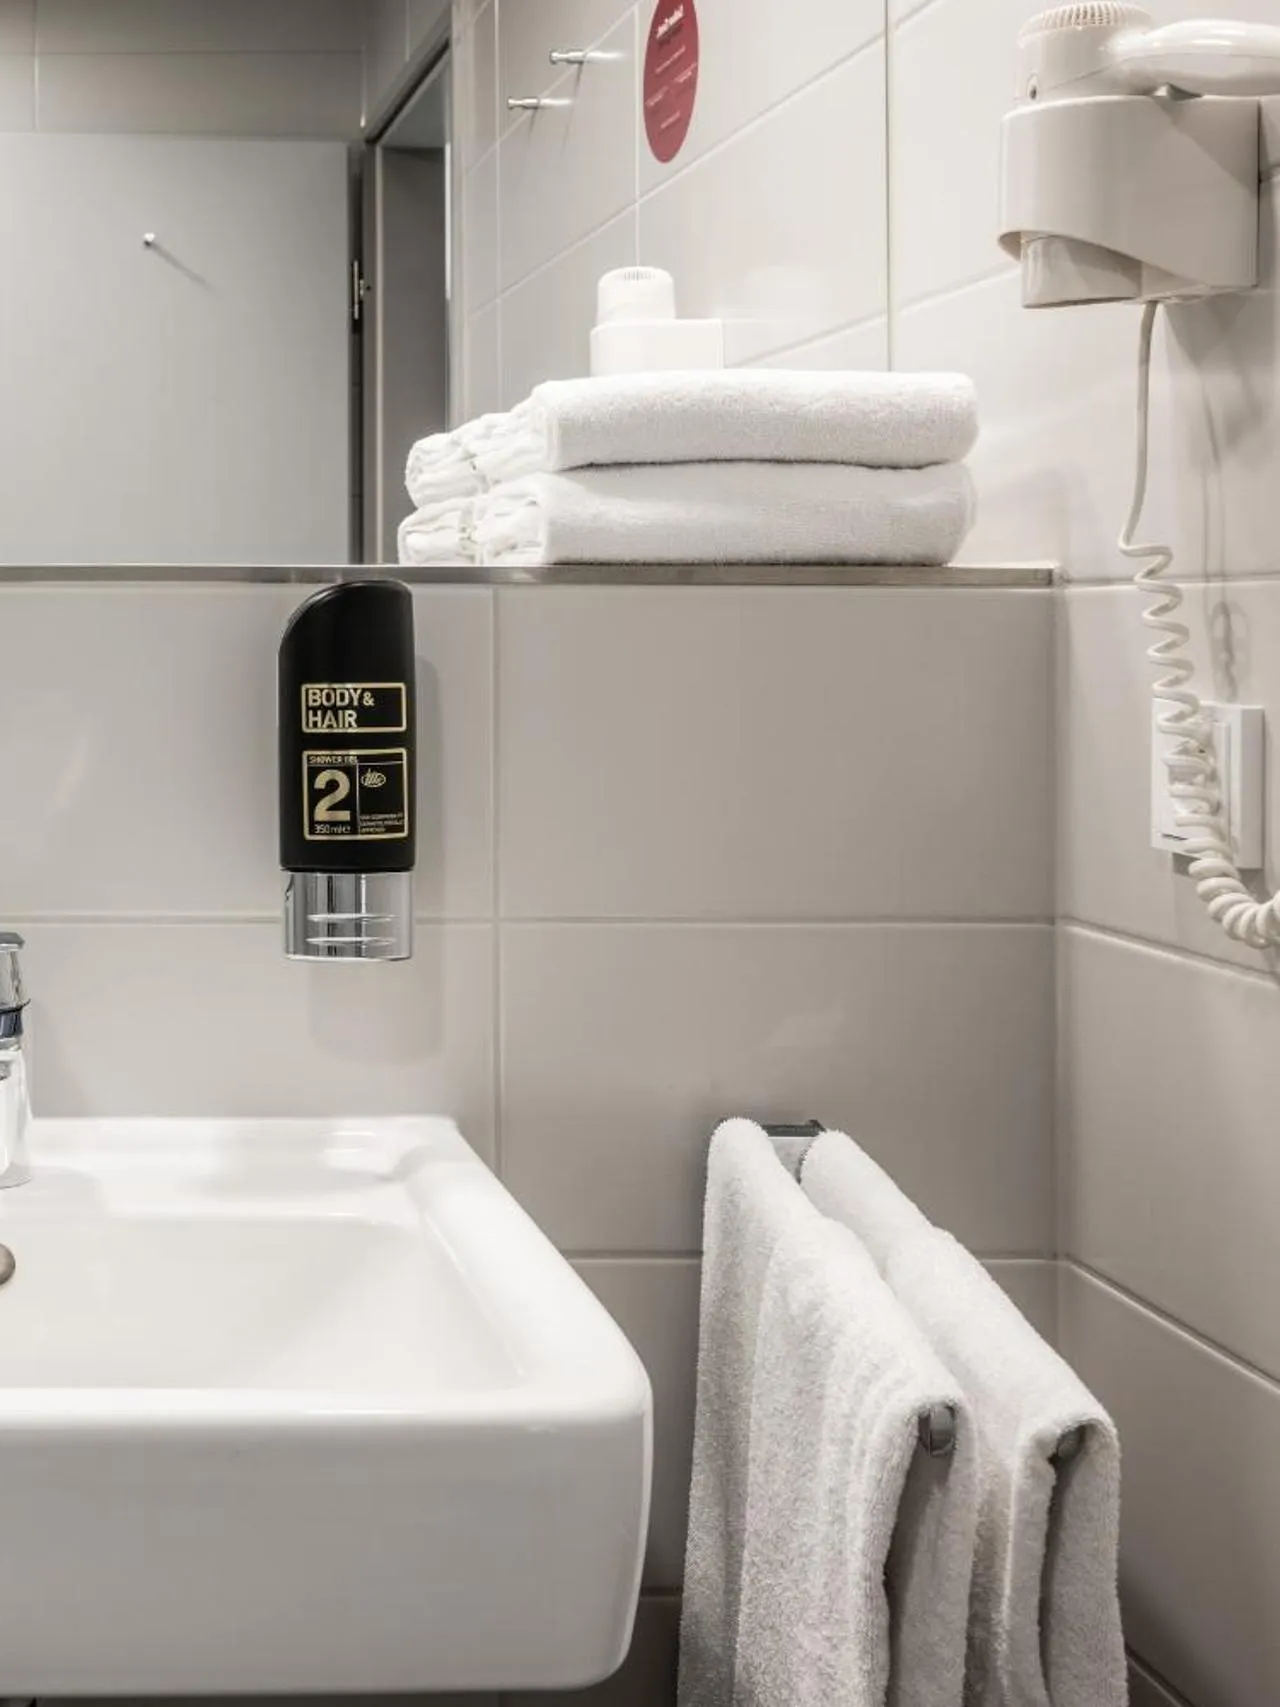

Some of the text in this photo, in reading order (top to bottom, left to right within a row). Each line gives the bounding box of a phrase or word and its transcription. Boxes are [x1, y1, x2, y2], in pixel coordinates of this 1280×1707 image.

[308, 709, 358, 729] HAIR
[308, 755, 342, 765] SHOWER
[314, 769, 351, 822] 2
